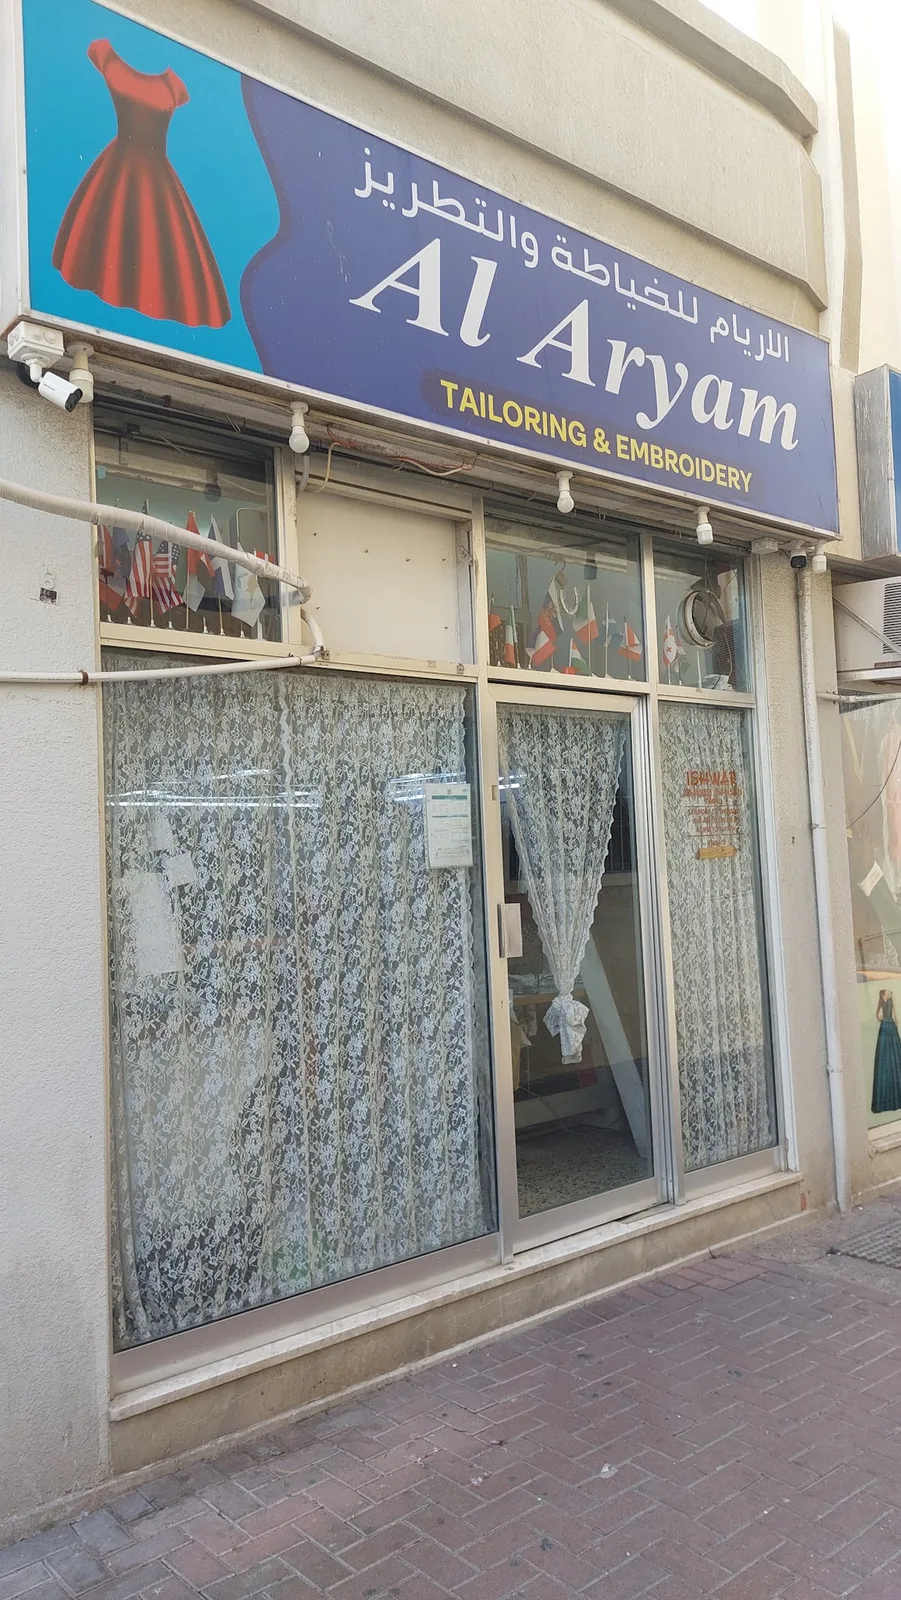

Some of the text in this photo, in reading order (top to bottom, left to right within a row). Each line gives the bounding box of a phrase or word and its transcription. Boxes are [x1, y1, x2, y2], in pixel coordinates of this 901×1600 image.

[353, 147, 540, 269] والتطريز
[551, 234, 699, 324] للخياطة
[349, 237, 799, 451] Al Aryam
[440, 379, 753, 494] TAILORING & EMBROIDERY
